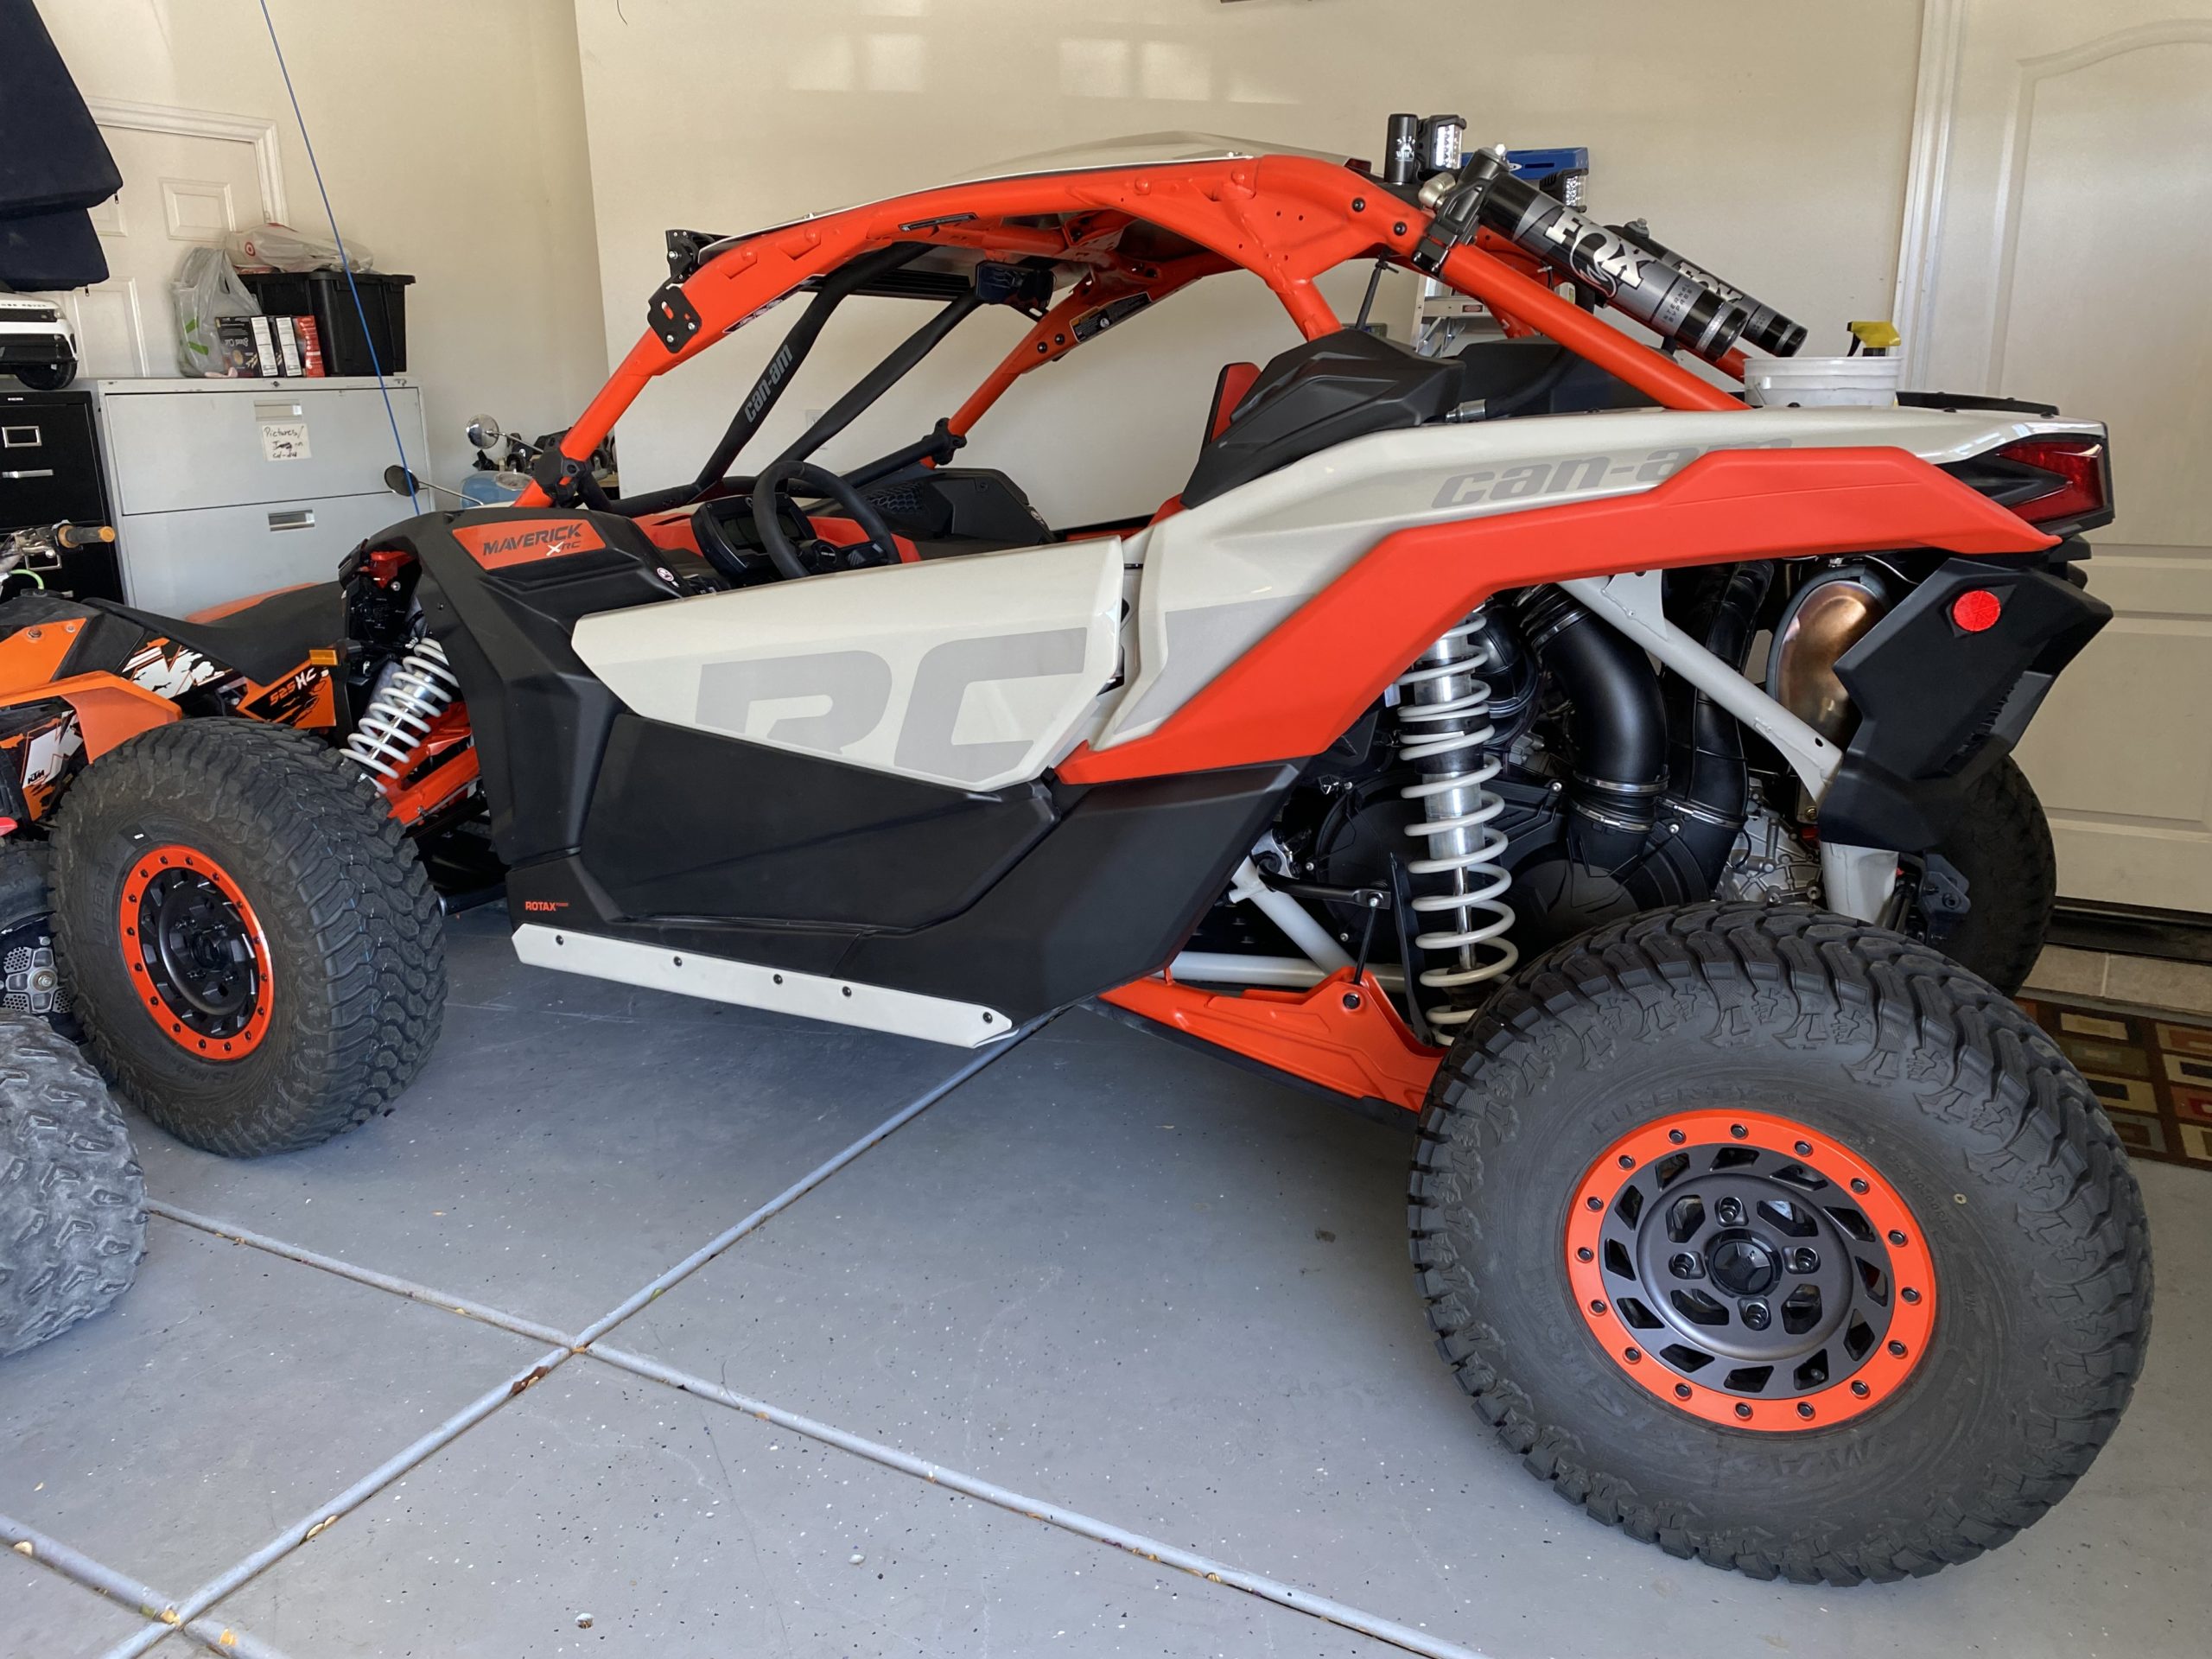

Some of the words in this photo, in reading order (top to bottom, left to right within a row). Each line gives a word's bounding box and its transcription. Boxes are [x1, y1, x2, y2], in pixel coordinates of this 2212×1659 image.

[1545, 207, 1656, 297] FOX
[745, 344, 793, 423] can-am
[1431, 438, 1792, 508] can-a
[483, 523, 582, 556] MAVERICK
[695, 626, 1088, 782] RC
[525, 901, 556, 912] ROTAX
